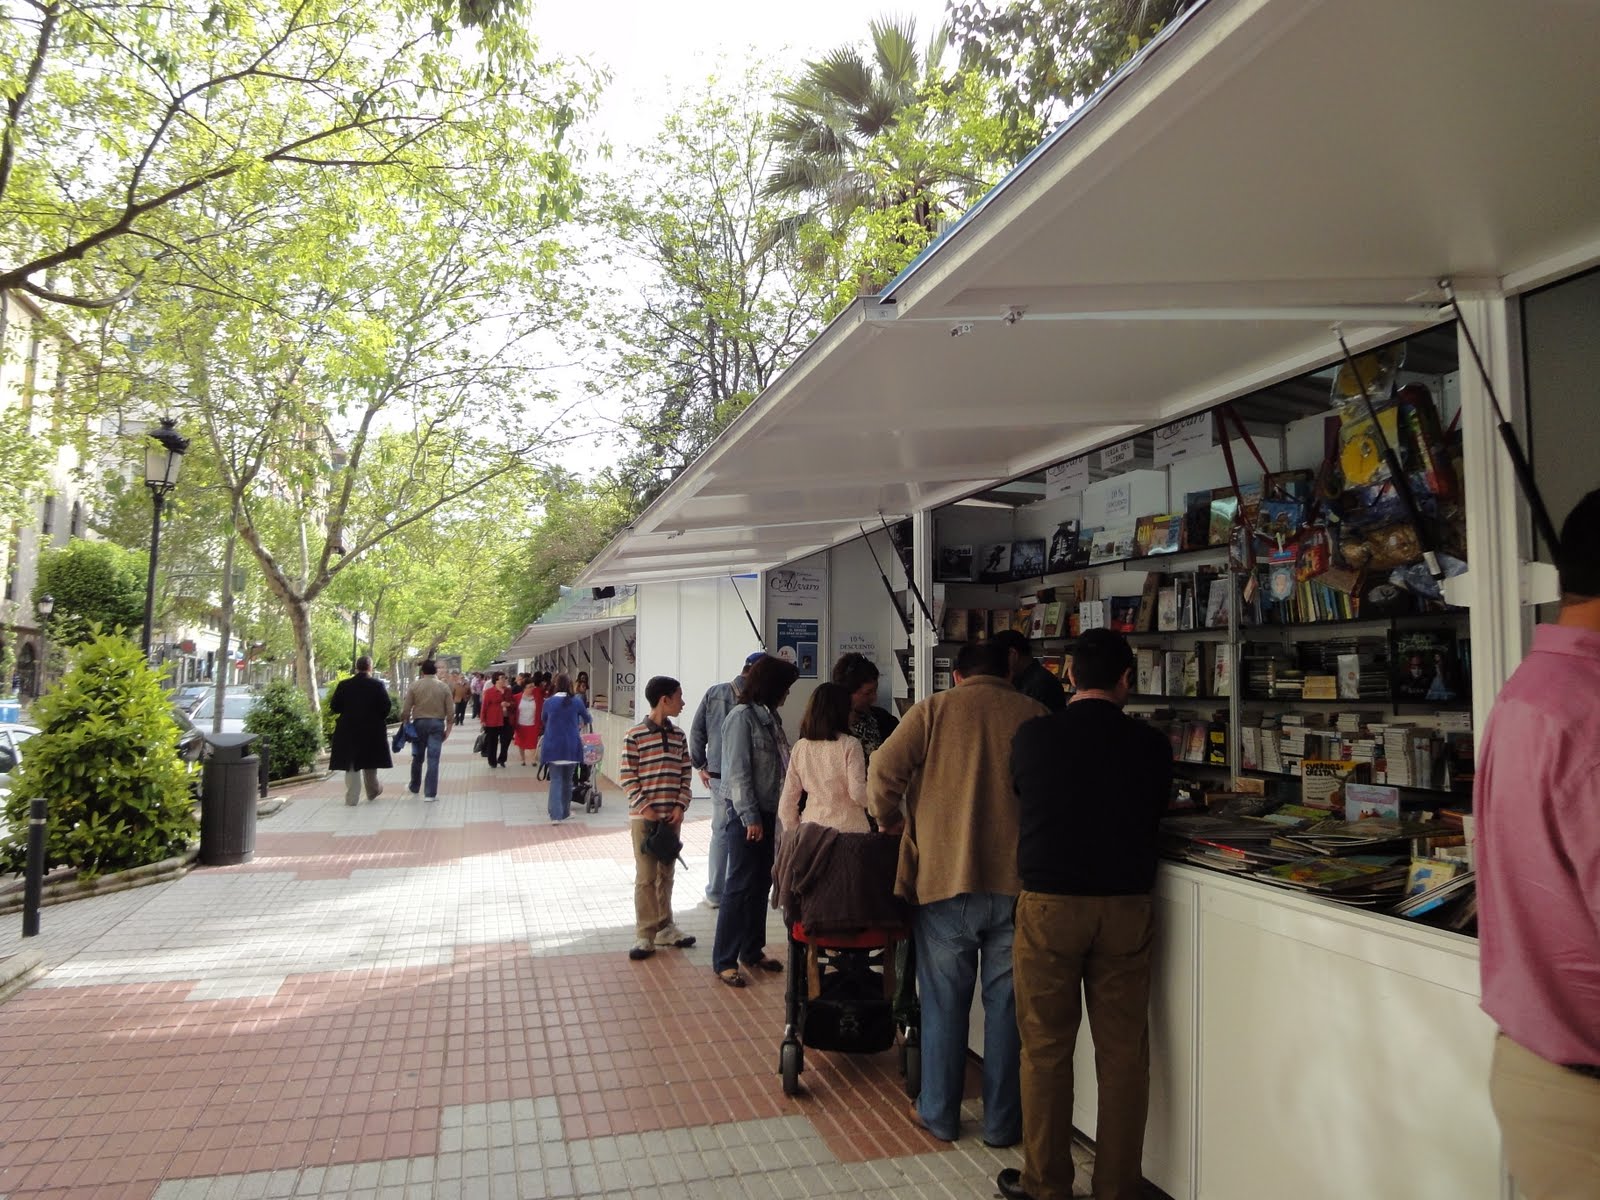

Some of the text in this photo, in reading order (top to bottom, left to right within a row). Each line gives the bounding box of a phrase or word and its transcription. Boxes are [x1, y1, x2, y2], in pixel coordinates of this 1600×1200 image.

[1120, 442, 1130, 452] DEL
[1110, 453, 1125, 464] LIBRO
[1305, 763, 1341, 771] CUERNOS
